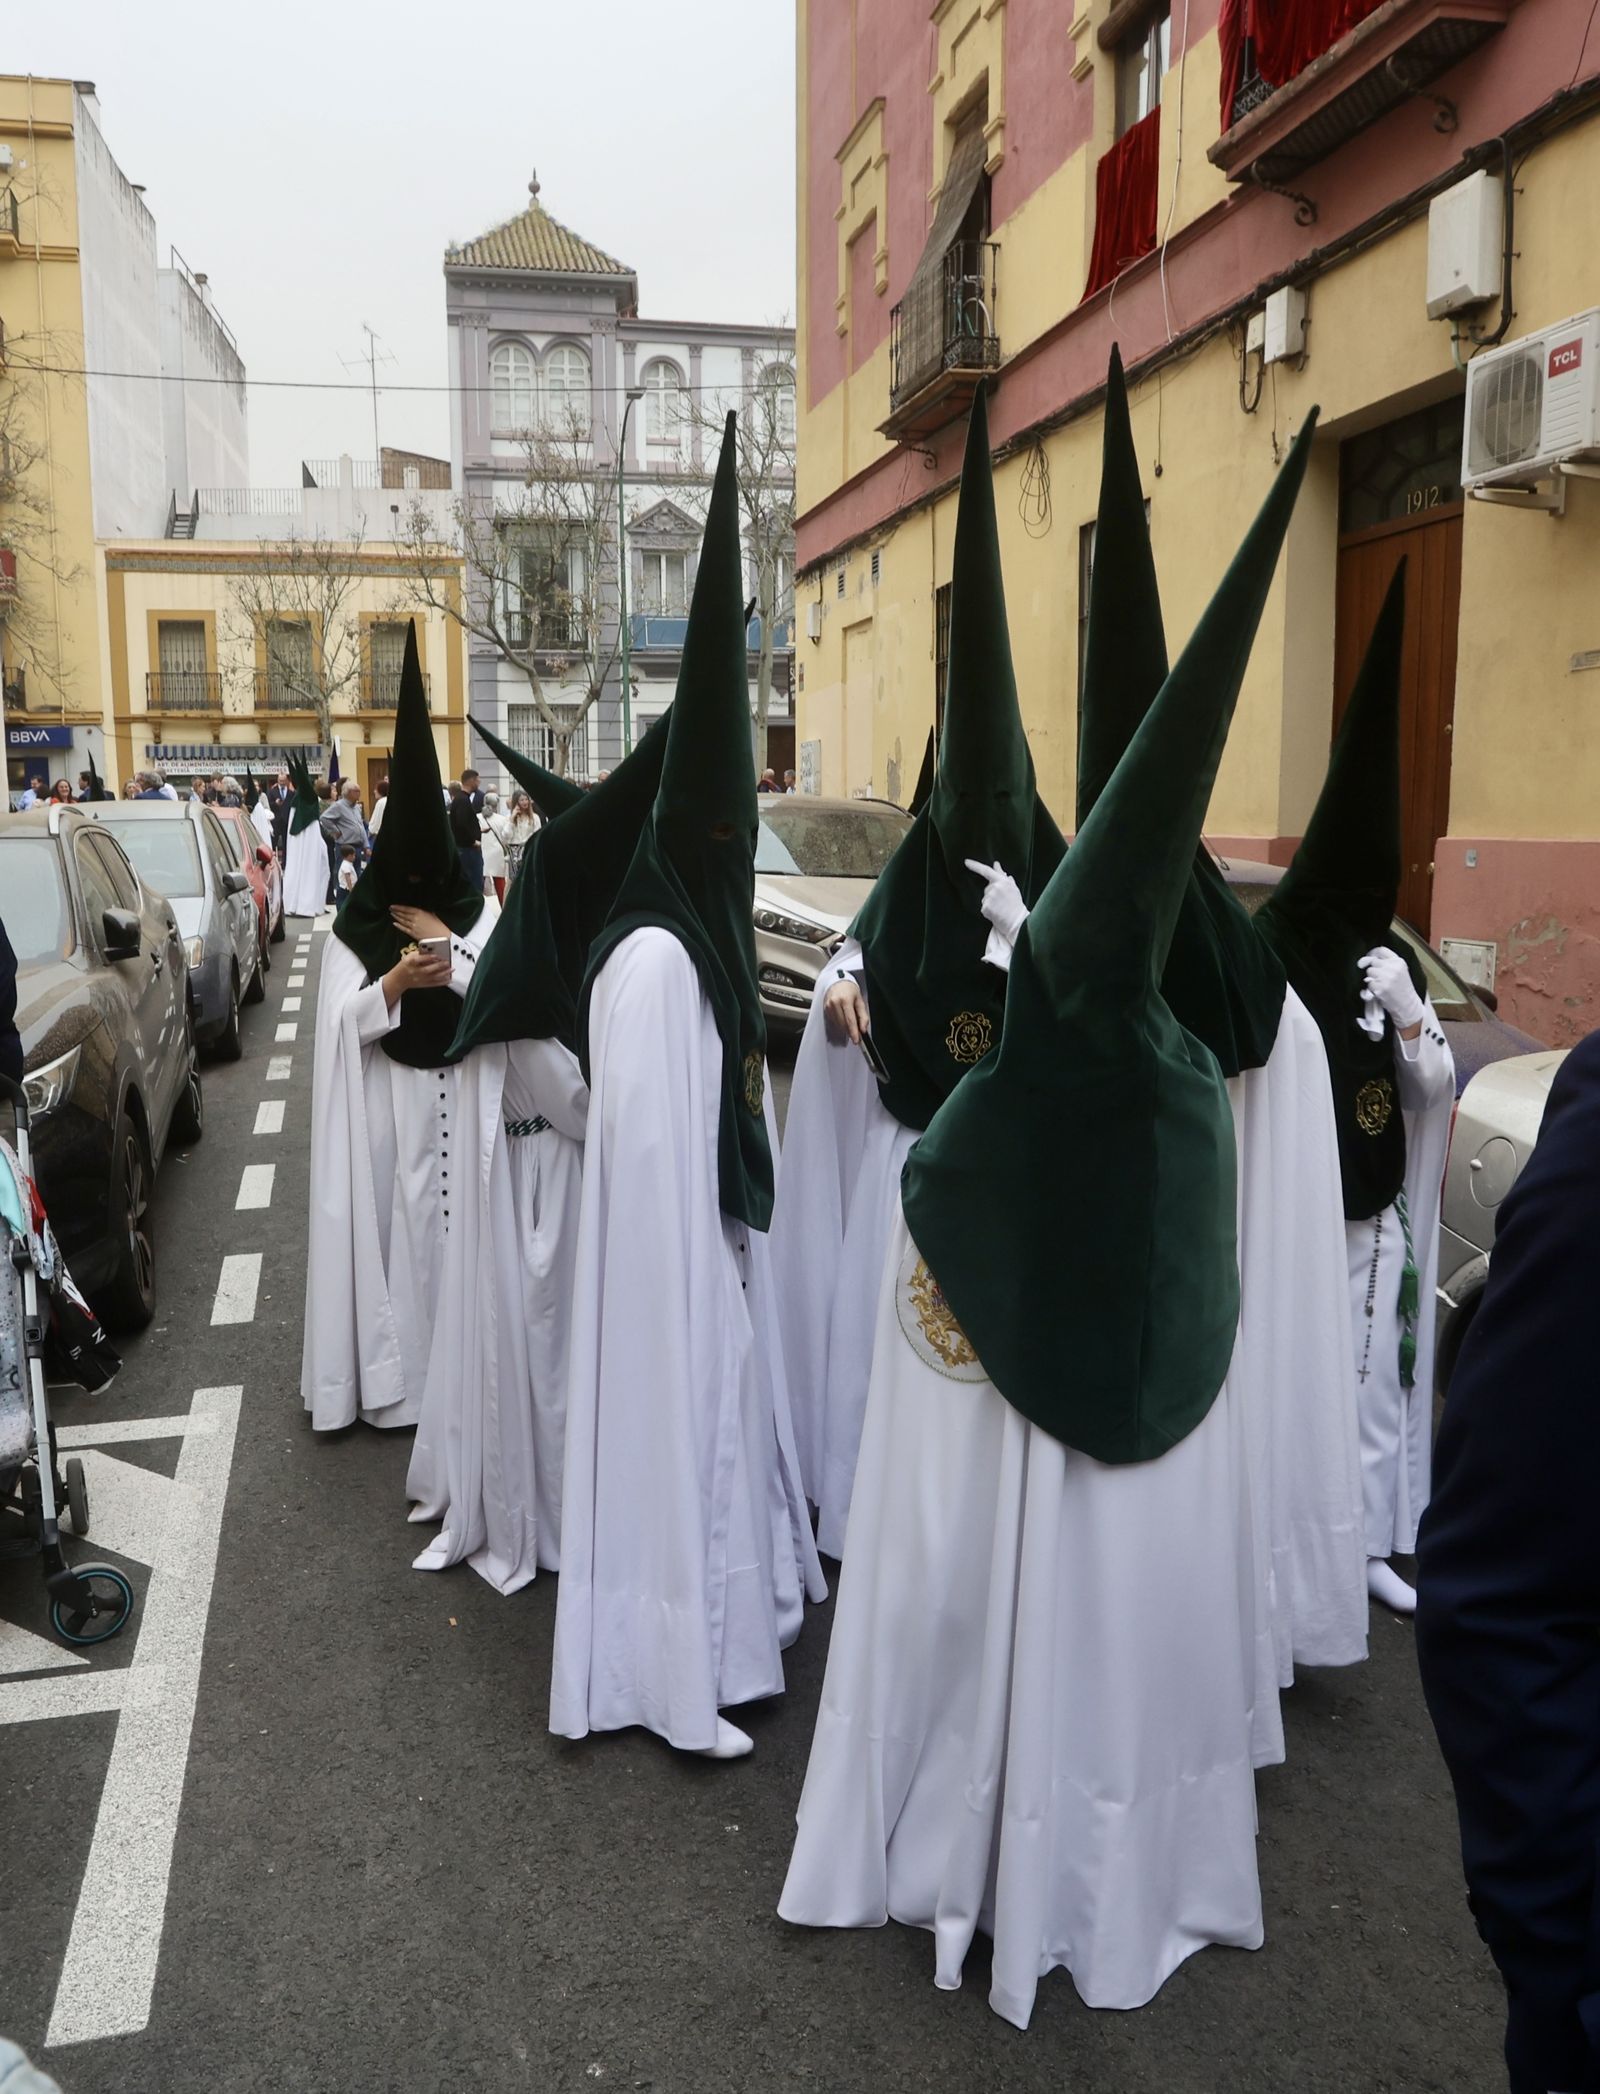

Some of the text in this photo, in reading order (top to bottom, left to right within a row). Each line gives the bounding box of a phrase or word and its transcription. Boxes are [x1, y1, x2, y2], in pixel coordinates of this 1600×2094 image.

[1553, 349, 1577, 367] TCL
[1407, 485, 1439, 515] 1912
[9, 729, 50, 743] BBVA
